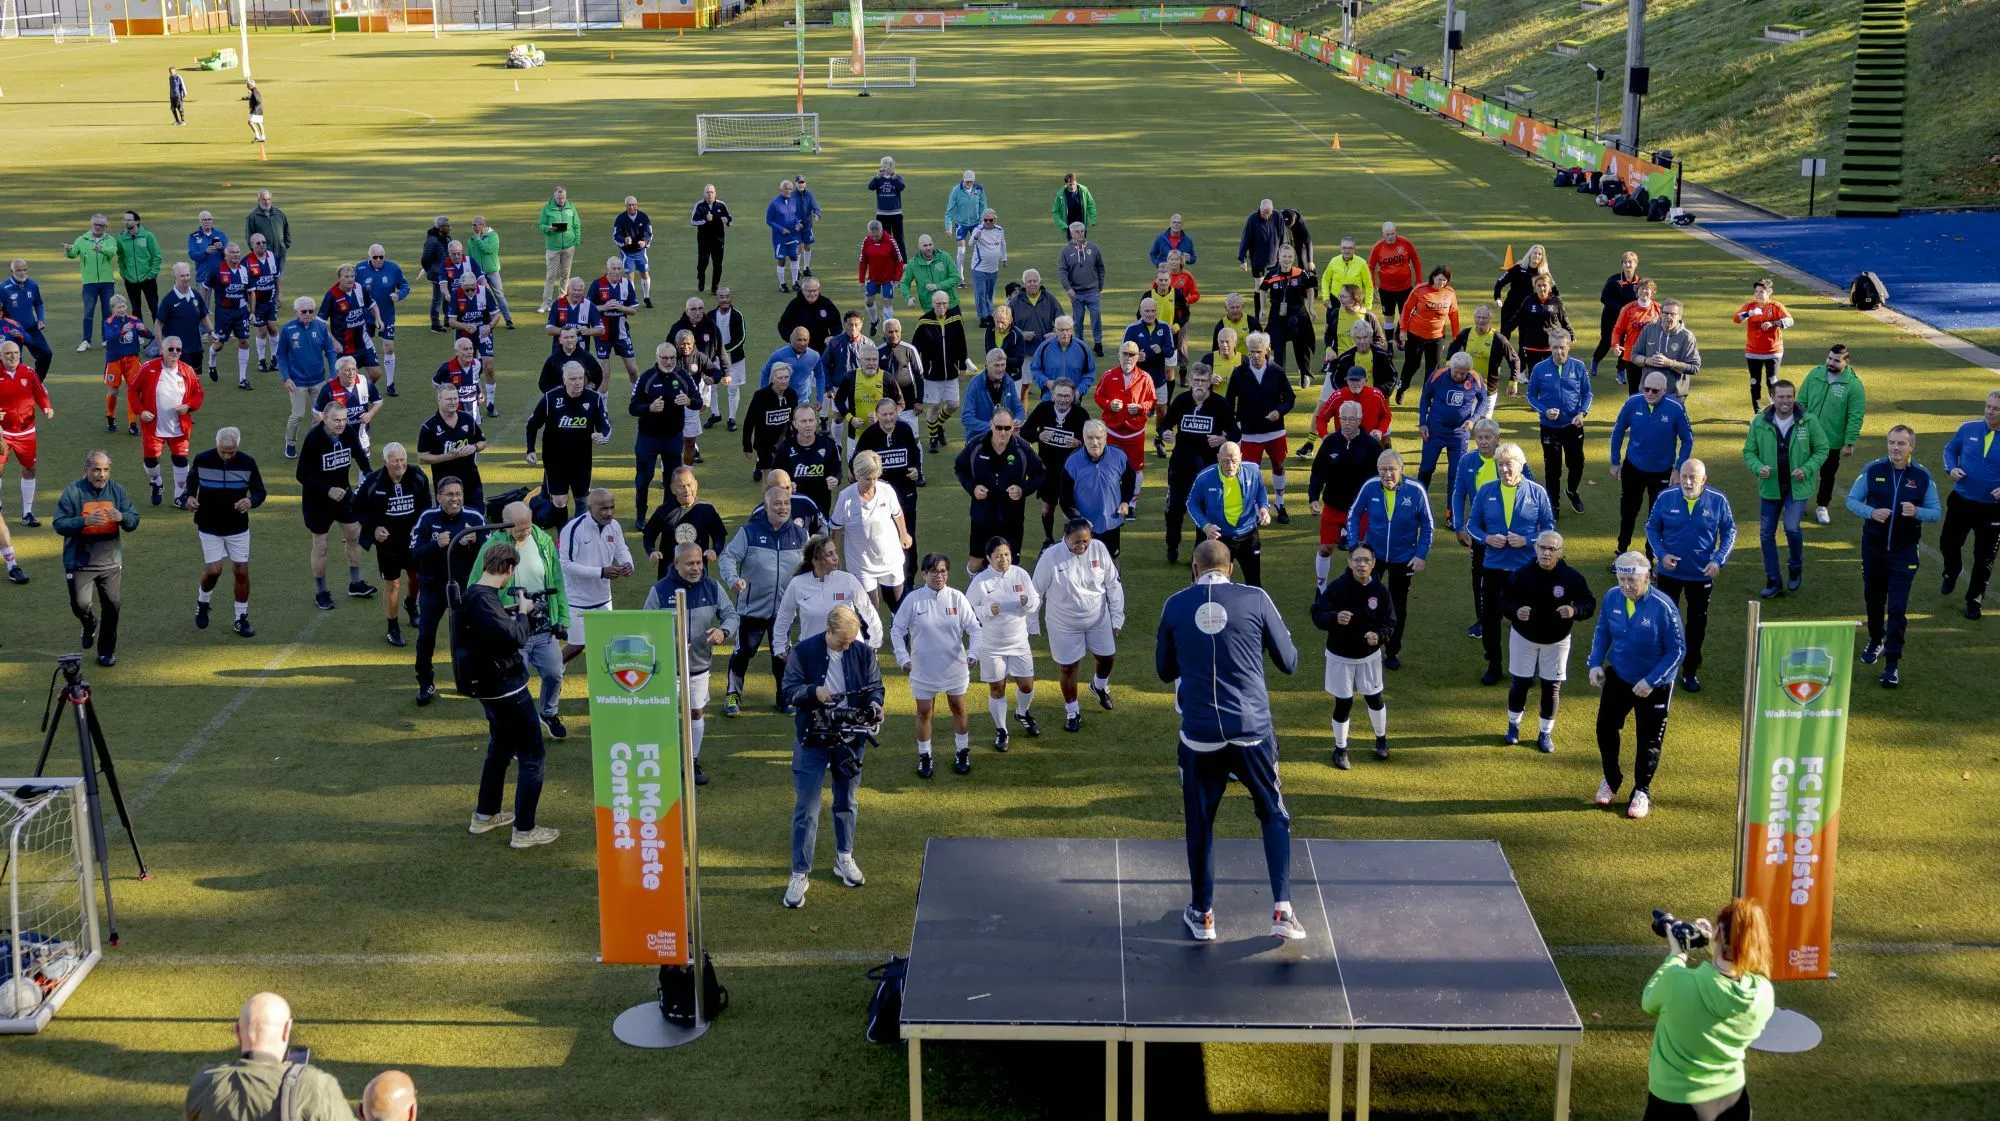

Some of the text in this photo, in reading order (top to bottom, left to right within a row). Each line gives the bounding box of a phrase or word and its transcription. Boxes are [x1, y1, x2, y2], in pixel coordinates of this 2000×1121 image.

[559, 415, 587, 428] fit20
[794, 463, 824, 477] fit20
[596, 695, 670, 705] Walking Football
[1765, 708, 1842, 719] Walking Football
[610, 742, 635, 849] Contact
[636, 743, 665, 890] FC Mooiste
[1765, 757, 1796, 865] Contact
[1790, 757, 1824, 905] FC Mooiste
